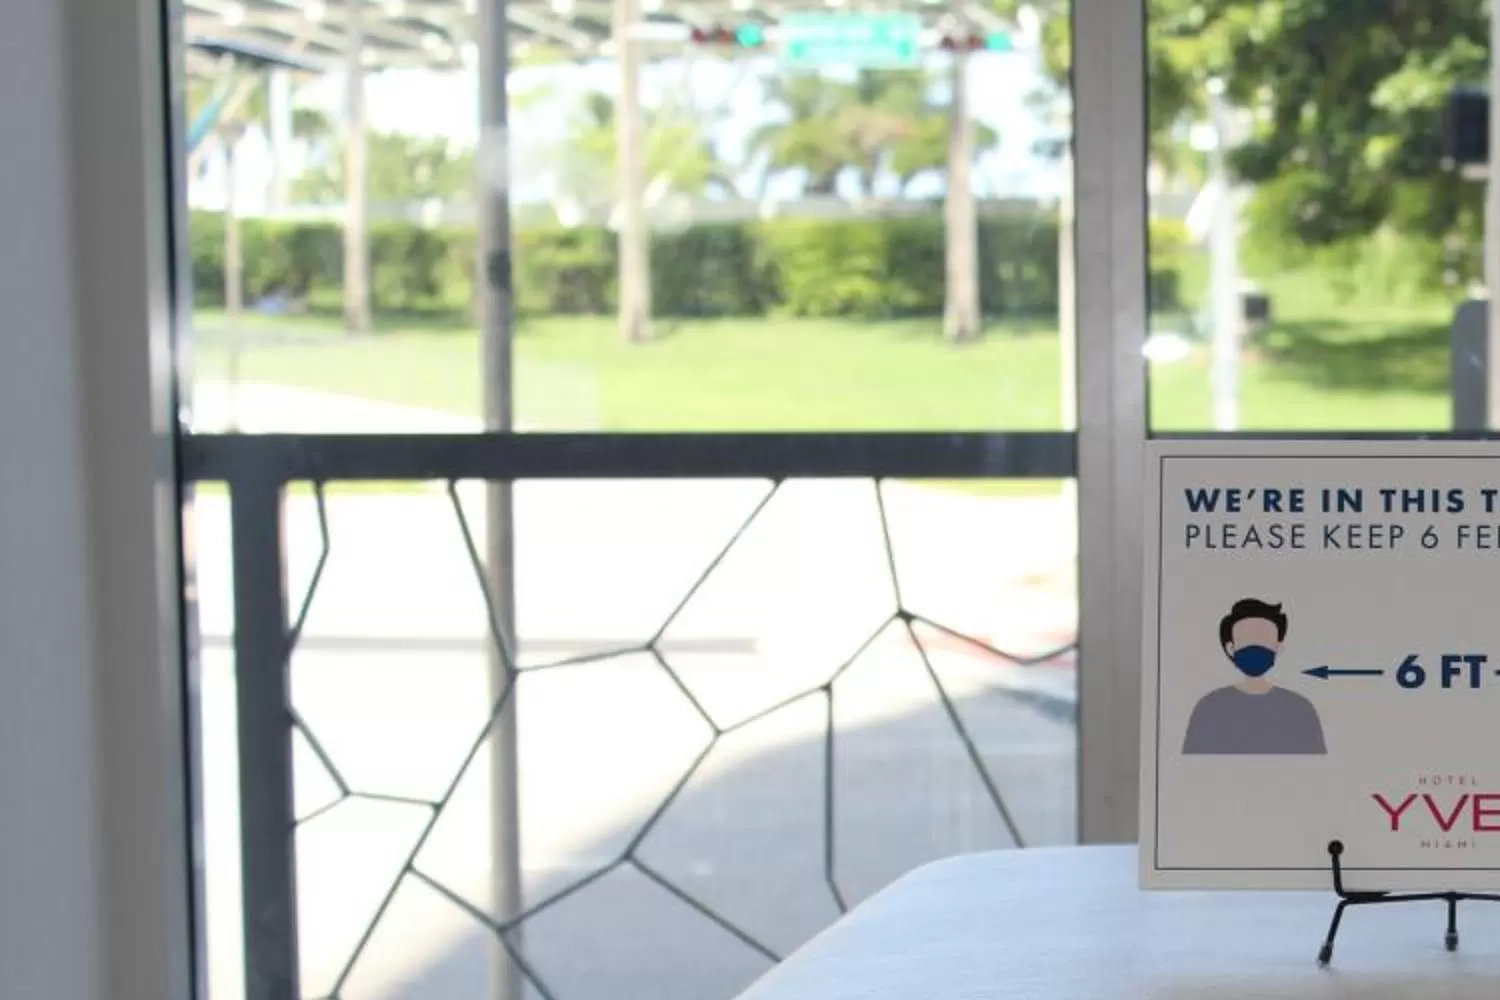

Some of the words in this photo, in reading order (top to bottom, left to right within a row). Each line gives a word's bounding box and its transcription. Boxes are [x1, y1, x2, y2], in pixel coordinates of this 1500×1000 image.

[1184, 487, 1306, 514] WE'RE
[1319, 487, 1365, 514] IN
[1378, 487, 1465, 514] THIS
[1184, 522, 1307, 550] PLEASE
[1322, 523, 1405, 550] KEEP
[1419, 524, 1440, 550] 6
[1395, 653, 1427, 690] 6
[1440, 653, 1489, 690] FT
[1418, 775, 1478, 786] HOTEL
[1420, 839, 1477, 849] MIAMI
